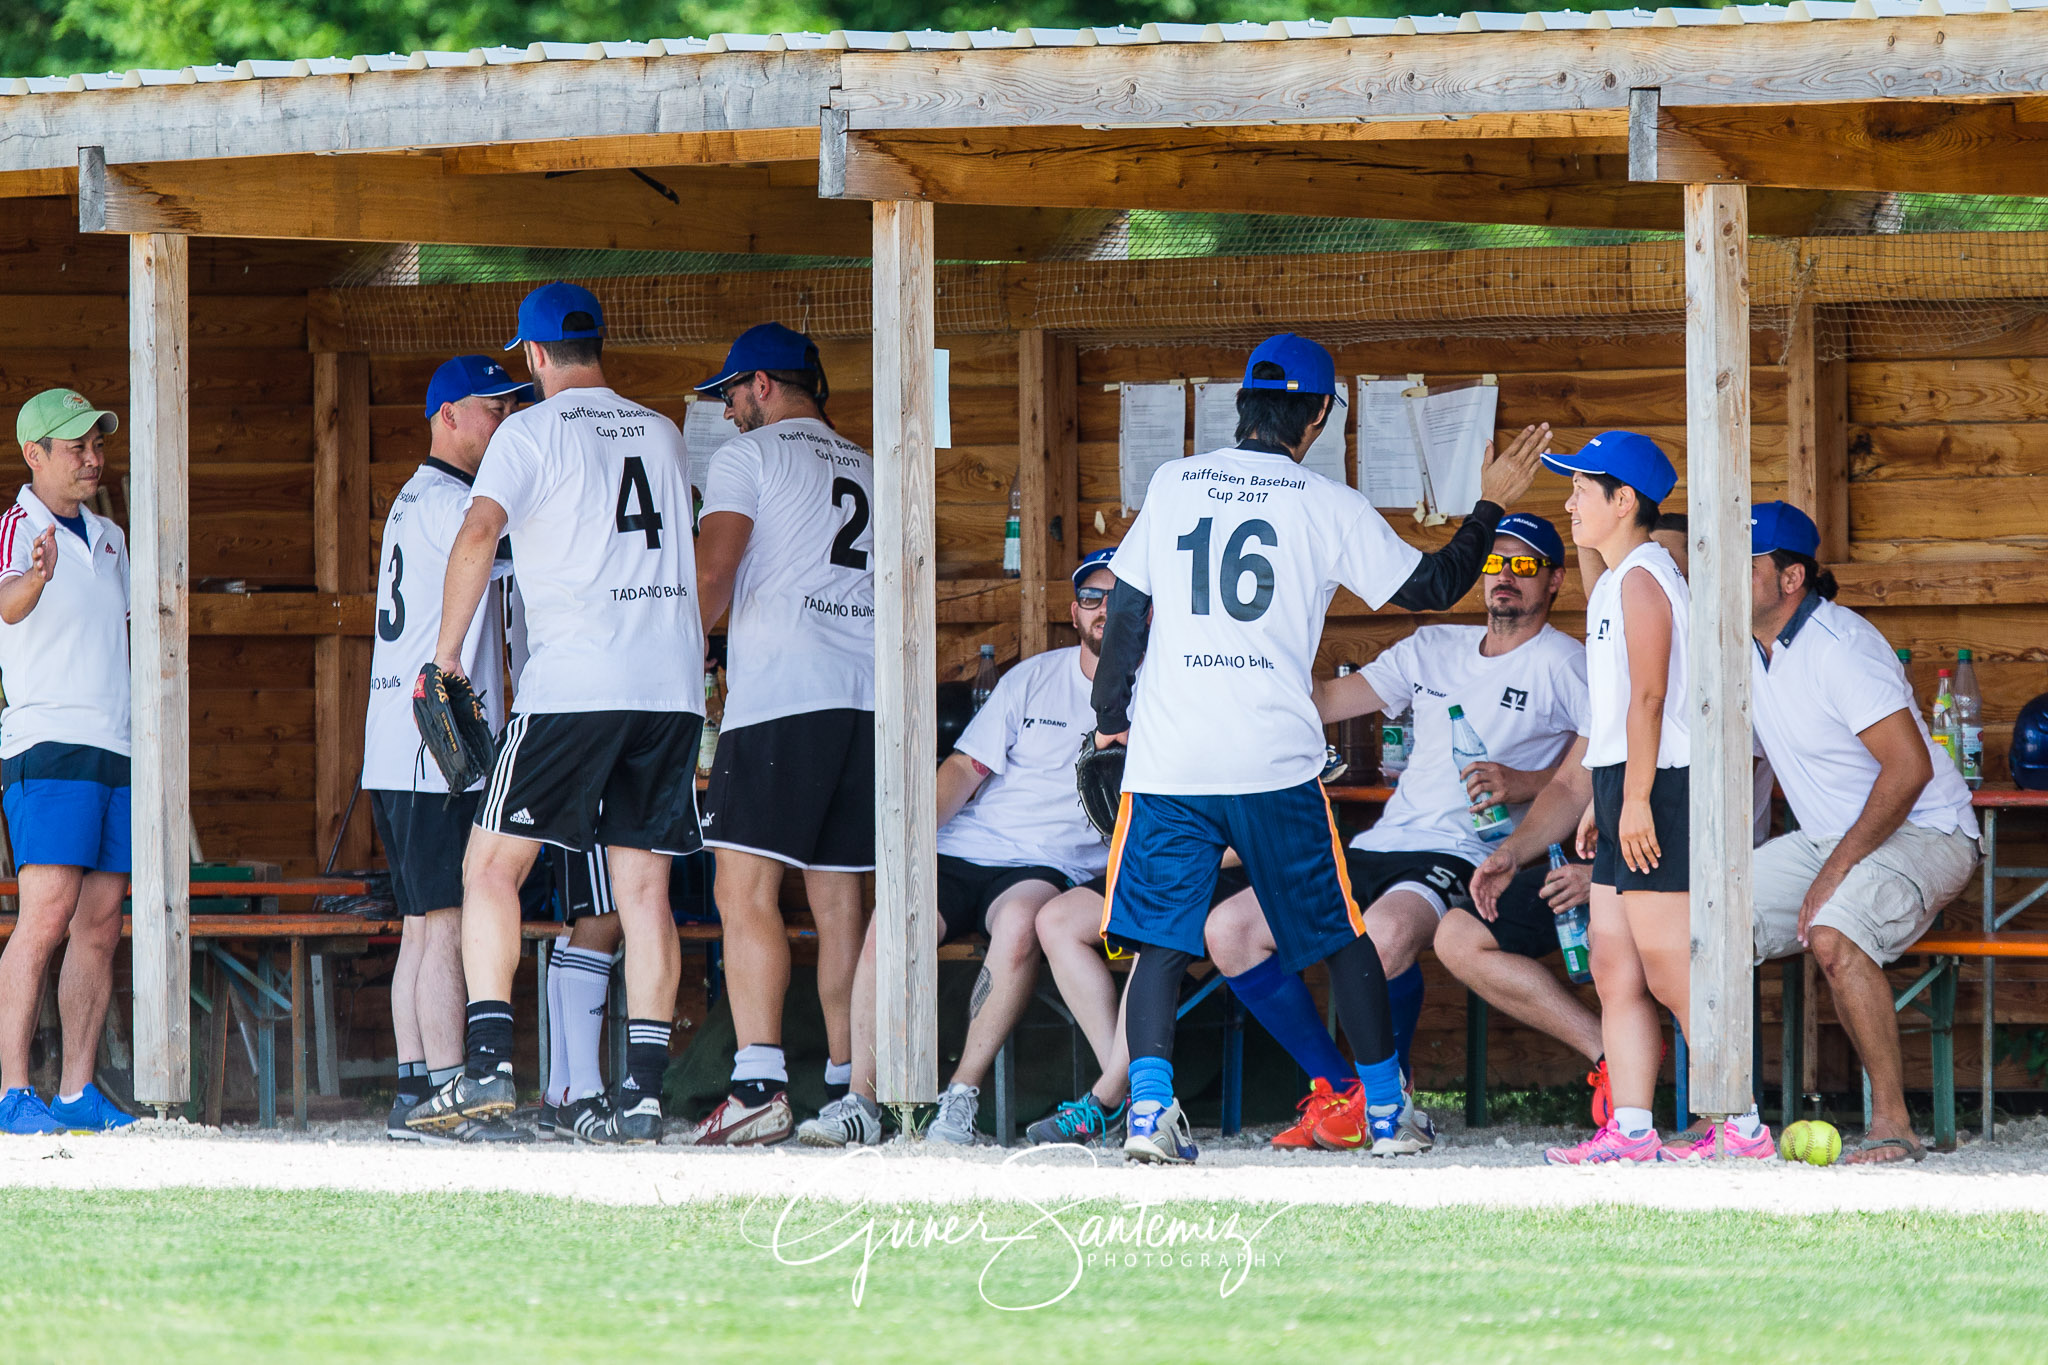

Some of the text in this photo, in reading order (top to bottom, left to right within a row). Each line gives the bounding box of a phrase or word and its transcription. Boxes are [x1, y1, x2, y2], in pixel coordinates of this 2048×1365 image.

[560, 406, 616, 422] Raiffeisen
[596, 425, 645, 440] Cup 2017
[778, 431, 833, 447] Raiffeisen
[835, 455, 861, 468] 2017
[1181, 468, 1306, 490] Raiffeisen Baseball
[616, 455, 664, 550] 4
[1207, 487, 1269, 504] Cup 2017
[829, 476, 870, 571] 2
[1176, 516, 1279, 622] 16
[610, 584, 662, 601] TADANO
[804, 595, 849, 617] TADANO
[1183, 654, 1246, 669] TADANO
[1426, 687, 1448, 698] TADA
[1039, 718, 1068, 728] TADANO
